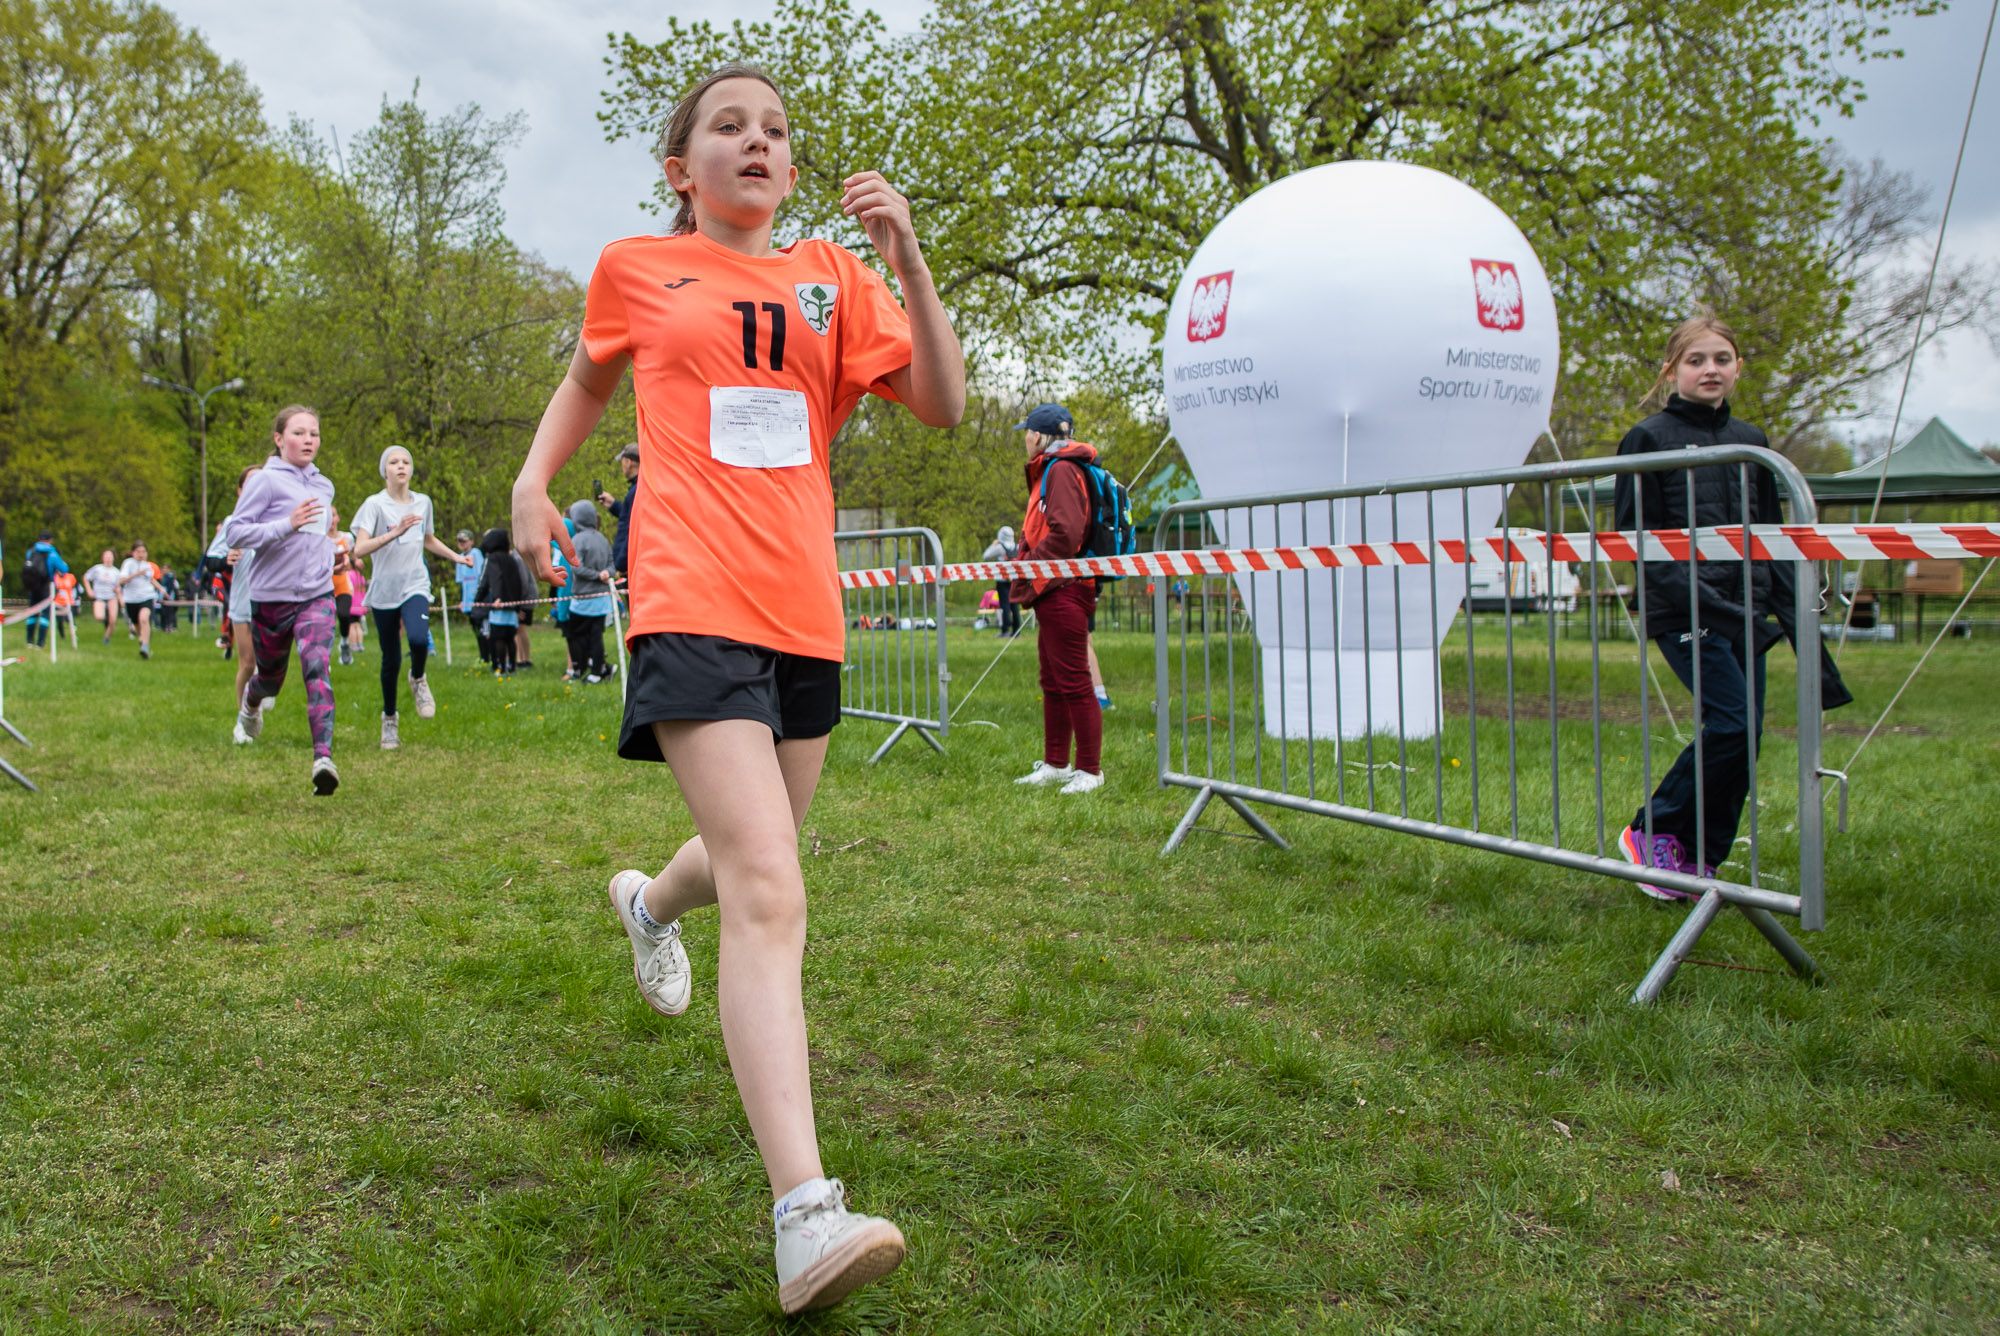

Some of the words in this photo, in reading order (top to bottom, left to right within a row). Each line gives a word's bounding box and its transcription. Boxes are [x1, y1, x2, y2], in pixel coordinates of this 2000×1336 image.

[732, 301, 786, 372] 11
[1173, 357, 1254, 384] Ministerstwo
[1447, 347, 1541, 375] Ministerstwo
[1201, 387, 1208, 406] i
[1206, 380, 1279, 408] Turystyki
[1419, 376, 1482, 401] Sportu
[1484, 378, 1491, 398] i
